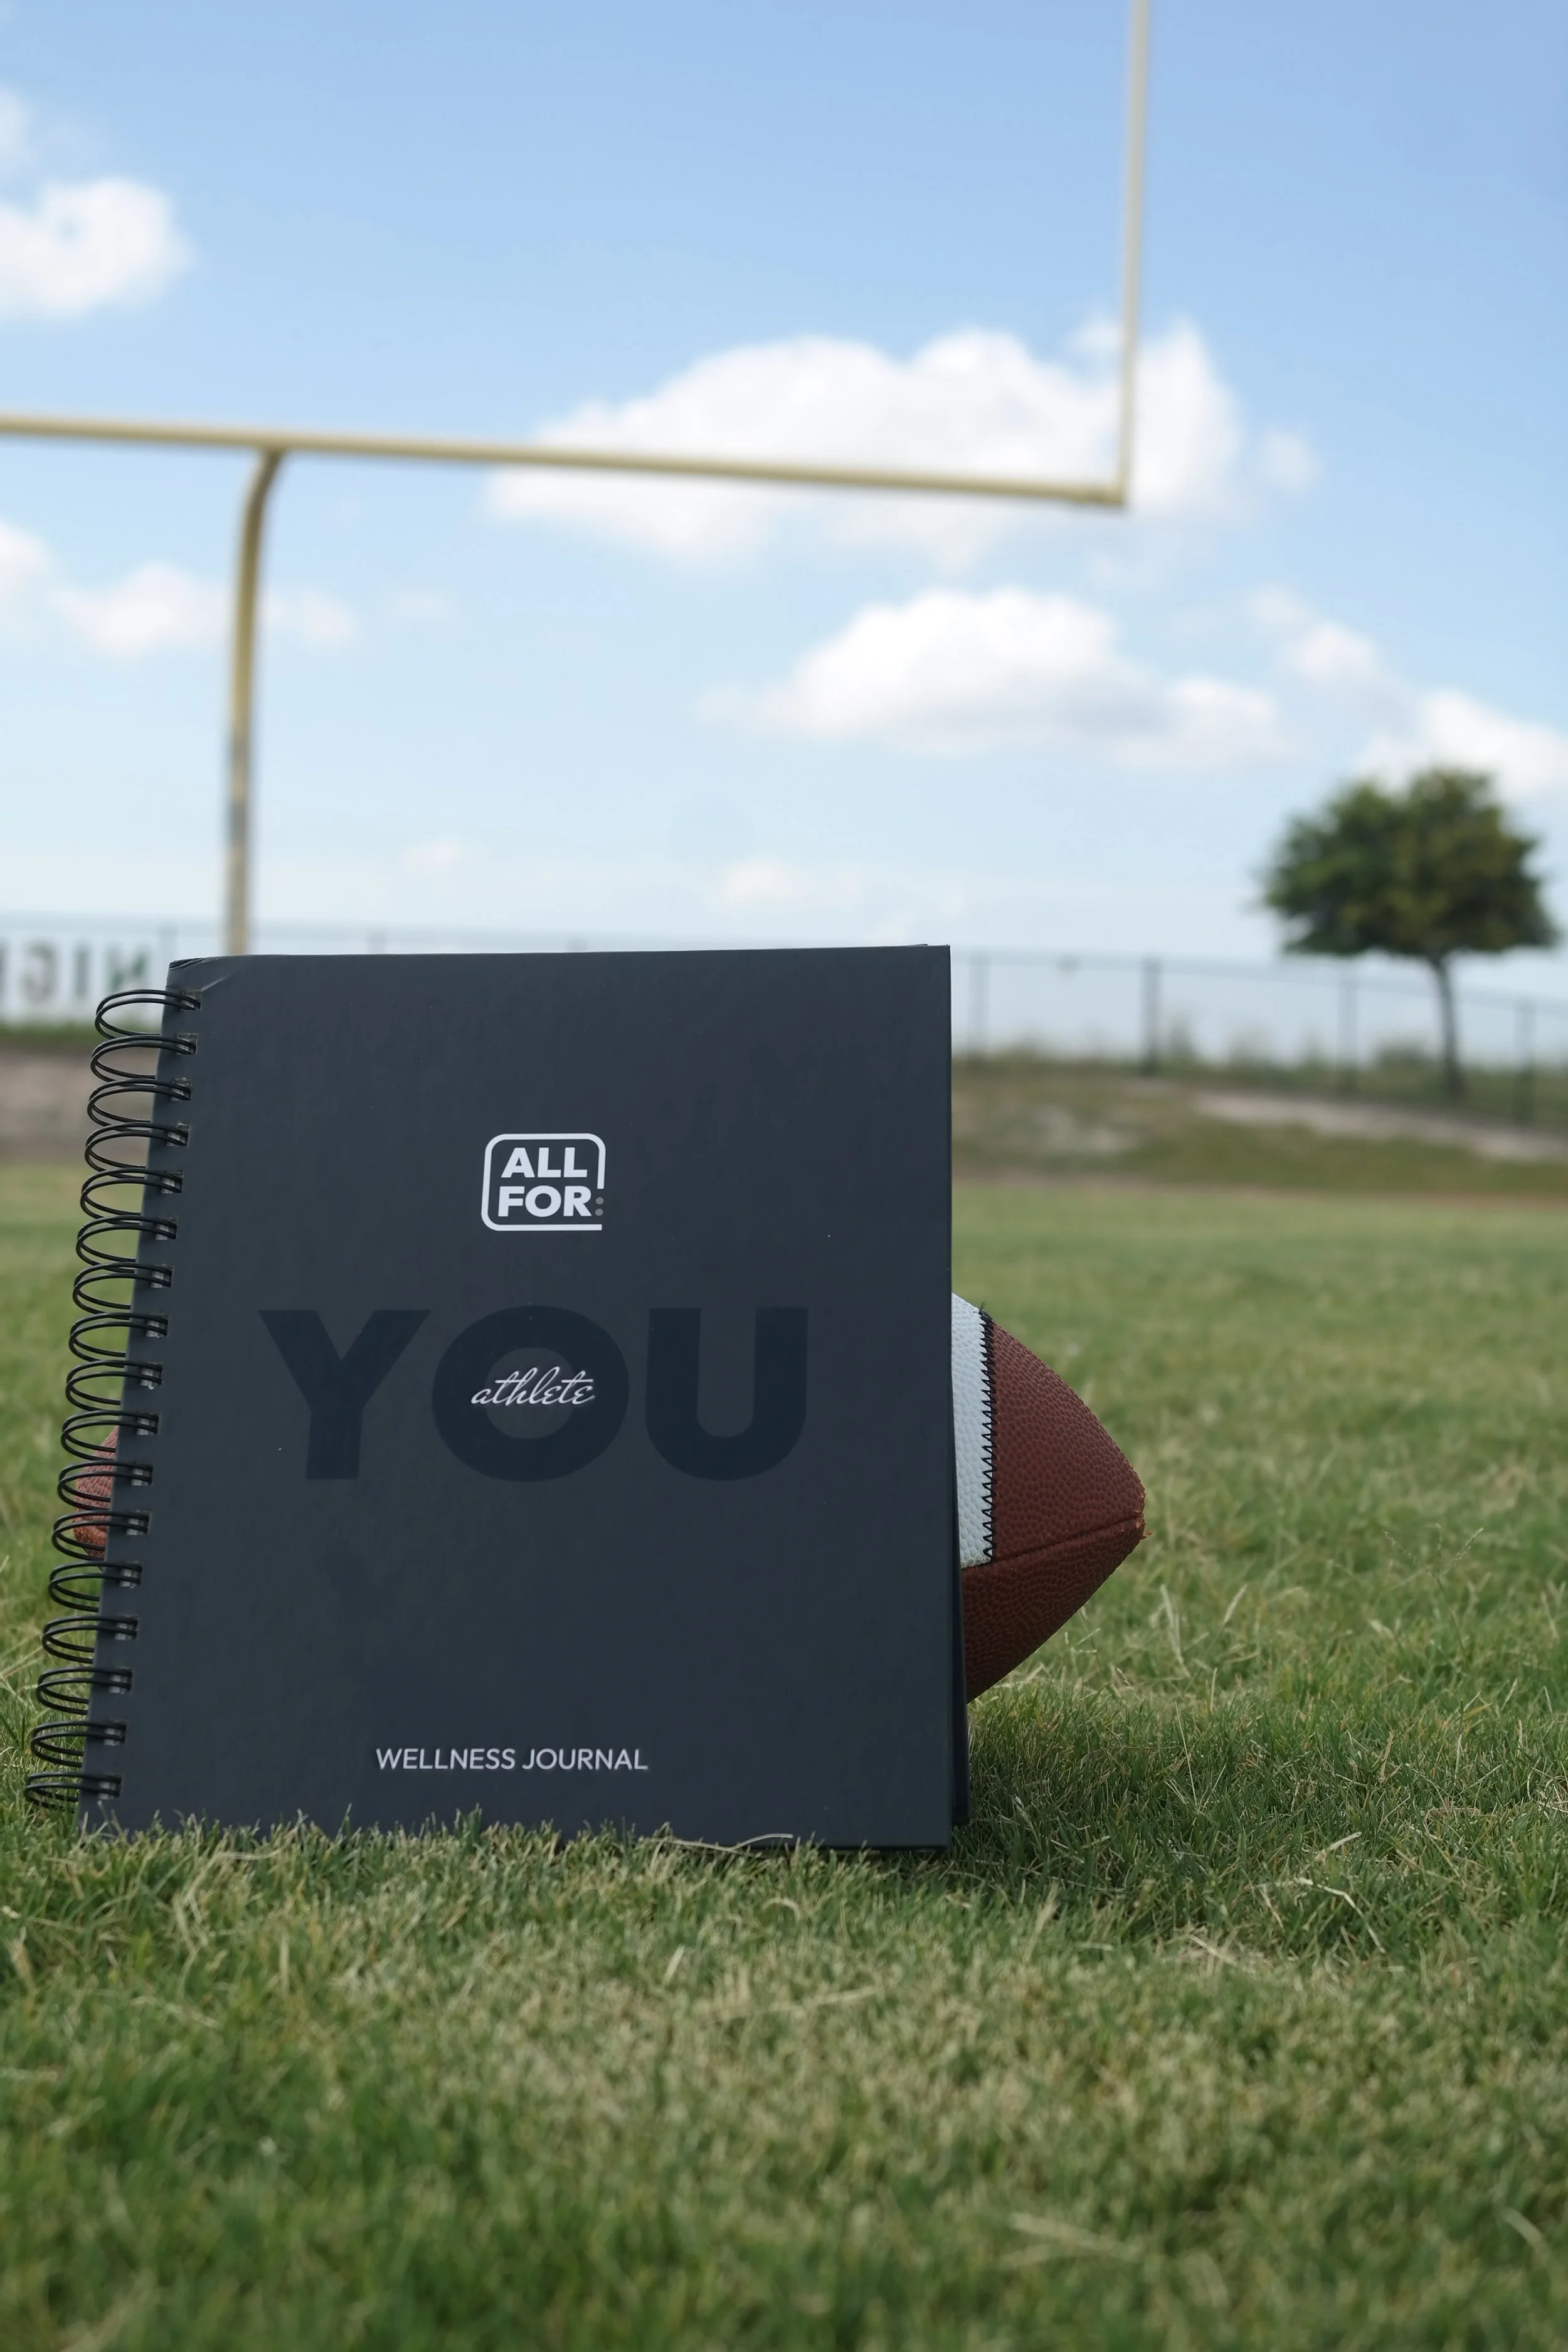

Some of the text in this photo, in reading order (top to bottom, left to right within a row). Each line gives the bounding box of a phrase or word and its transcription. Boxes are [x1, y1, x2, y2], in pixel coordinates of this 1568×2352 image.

[501, 1147, 588, 1178] ALL
[257, 1305, 809, 1482] YOU
[470, 1366, 595, 1406] athlete
[376, 1748, 649, 1770] WELLNESS JOURNAL
